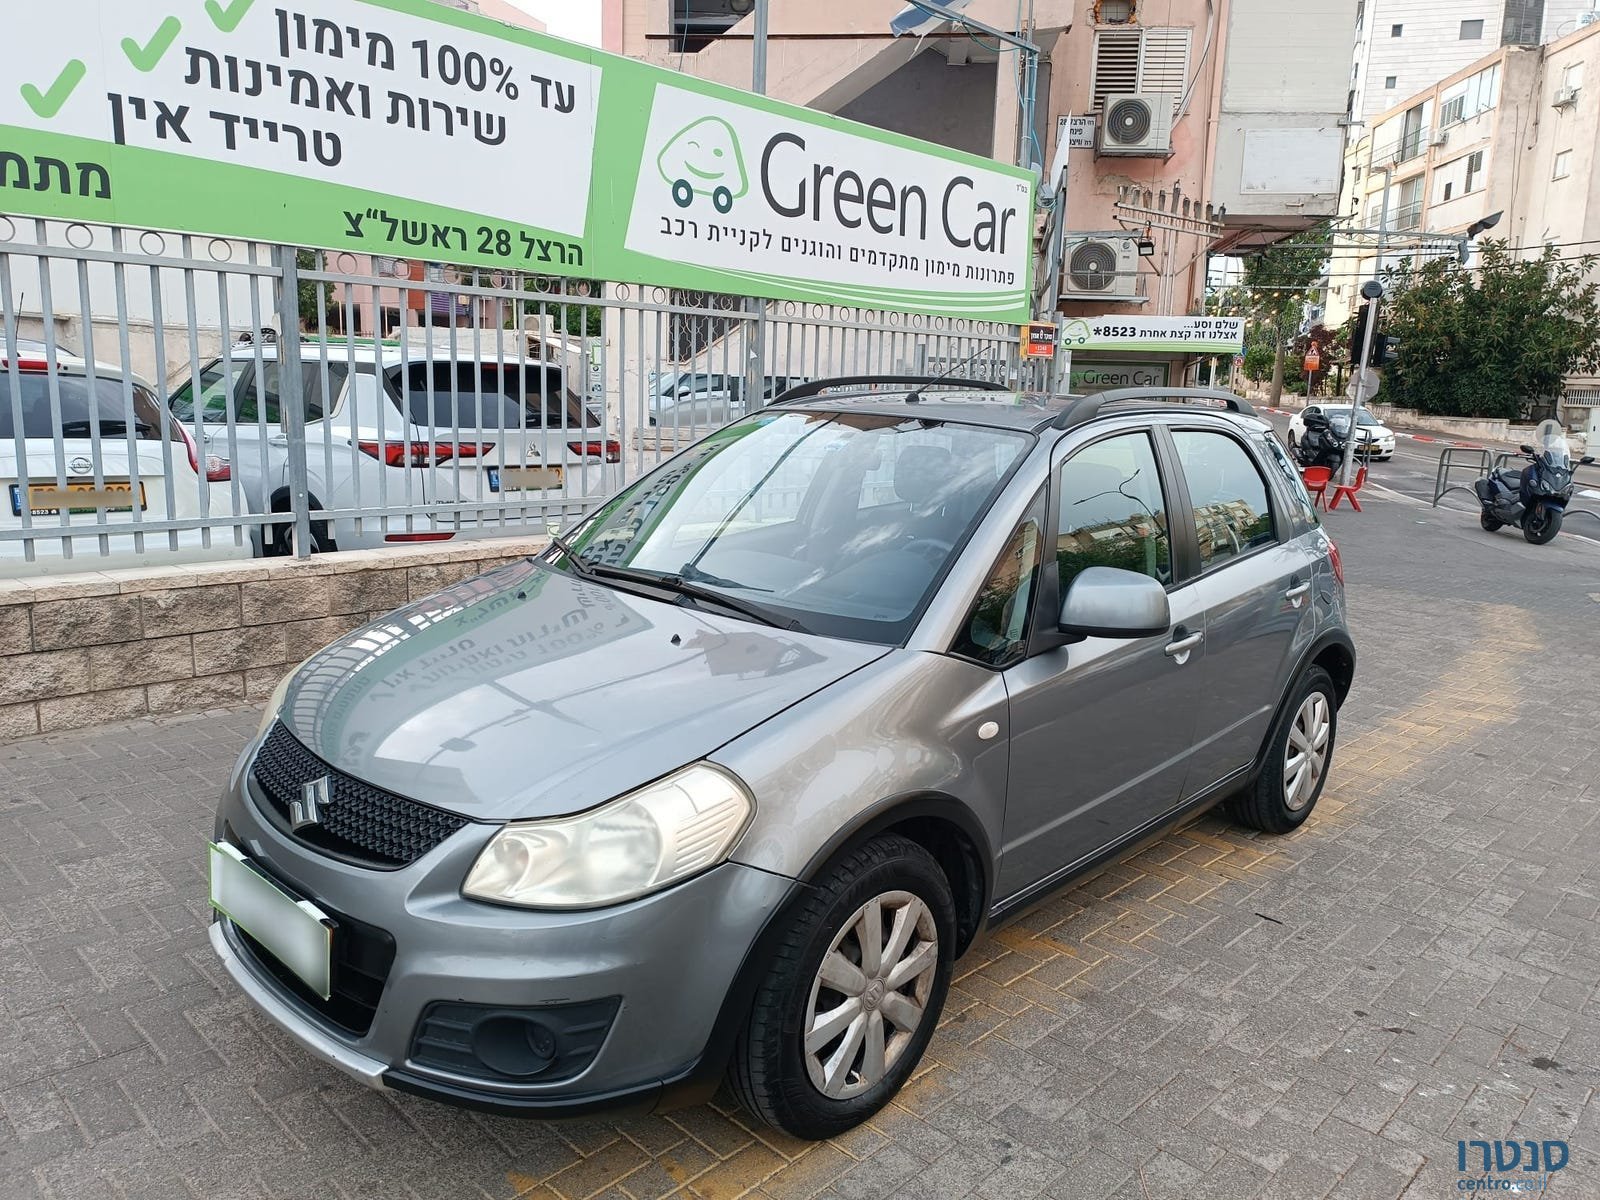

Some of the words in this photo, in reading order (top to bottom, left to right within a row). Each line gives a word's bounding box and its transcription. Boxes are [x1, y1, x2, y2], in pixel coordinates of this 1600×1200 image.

[275, 9, 394, 70] מימון
[185, 47, 370, 119] ואמינות
[412, 40, 518, 100] 100%
[531, 74, 575, 113] עד
[108, 93, 191, 145] אין
[387, 91, 505, 145] שירות
[210, 111, 341, 166] טרייד
[761, 132, 927, 241] Green
[942, 176, 1016, 254] Car
[661, 216, 698, 239] רכב
[707, 224, 772, 252] לקניית
[477, 227, 511, 256] 28
[520, 231, 583, 266] הרצל
[782, 236, 841, 260] והוגנים
[850, 246, 919, 271] מתקדמים
[925, 258, 960, 277] מימון
[965, 266, 1015, 286] פתרונות
[1139, 330, 1167, 338] אחרת
[1170, 330, 1191, 340] קצת
[1195, 330, 1206, 339] זה
[1209, 330, 1237, 339] אצלנו
[1215, 320, 1238, 329] שלם
[1083, 369, 1129, 384] Green
[1133, 370, 1159, 386] Car
